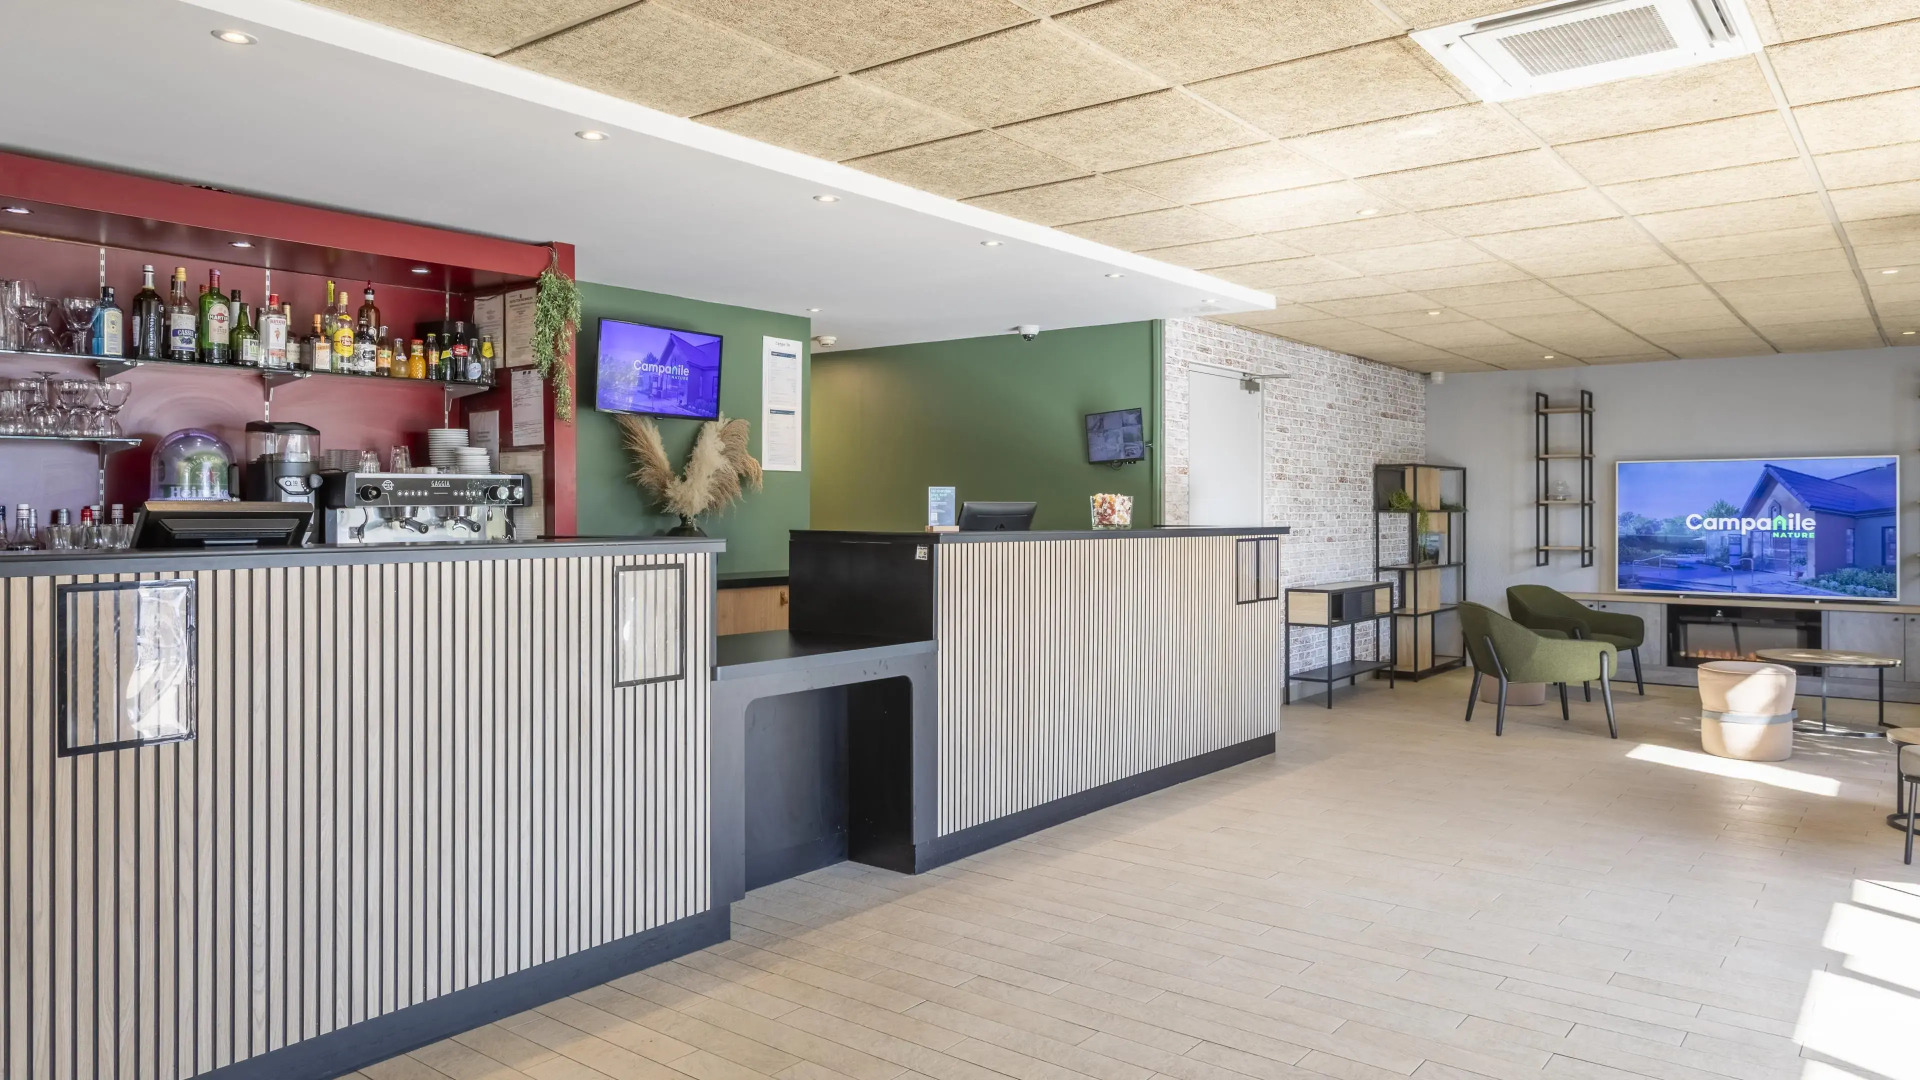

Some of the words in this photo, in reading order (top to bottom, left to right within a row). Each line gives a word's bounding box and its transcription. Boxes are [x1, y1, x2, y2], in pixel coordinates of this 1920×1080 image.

[633, 359, 690, 378] Campanile
[169, 486, 229, 499] Heineke
[1685, 513, 1816, 536] Campanile
